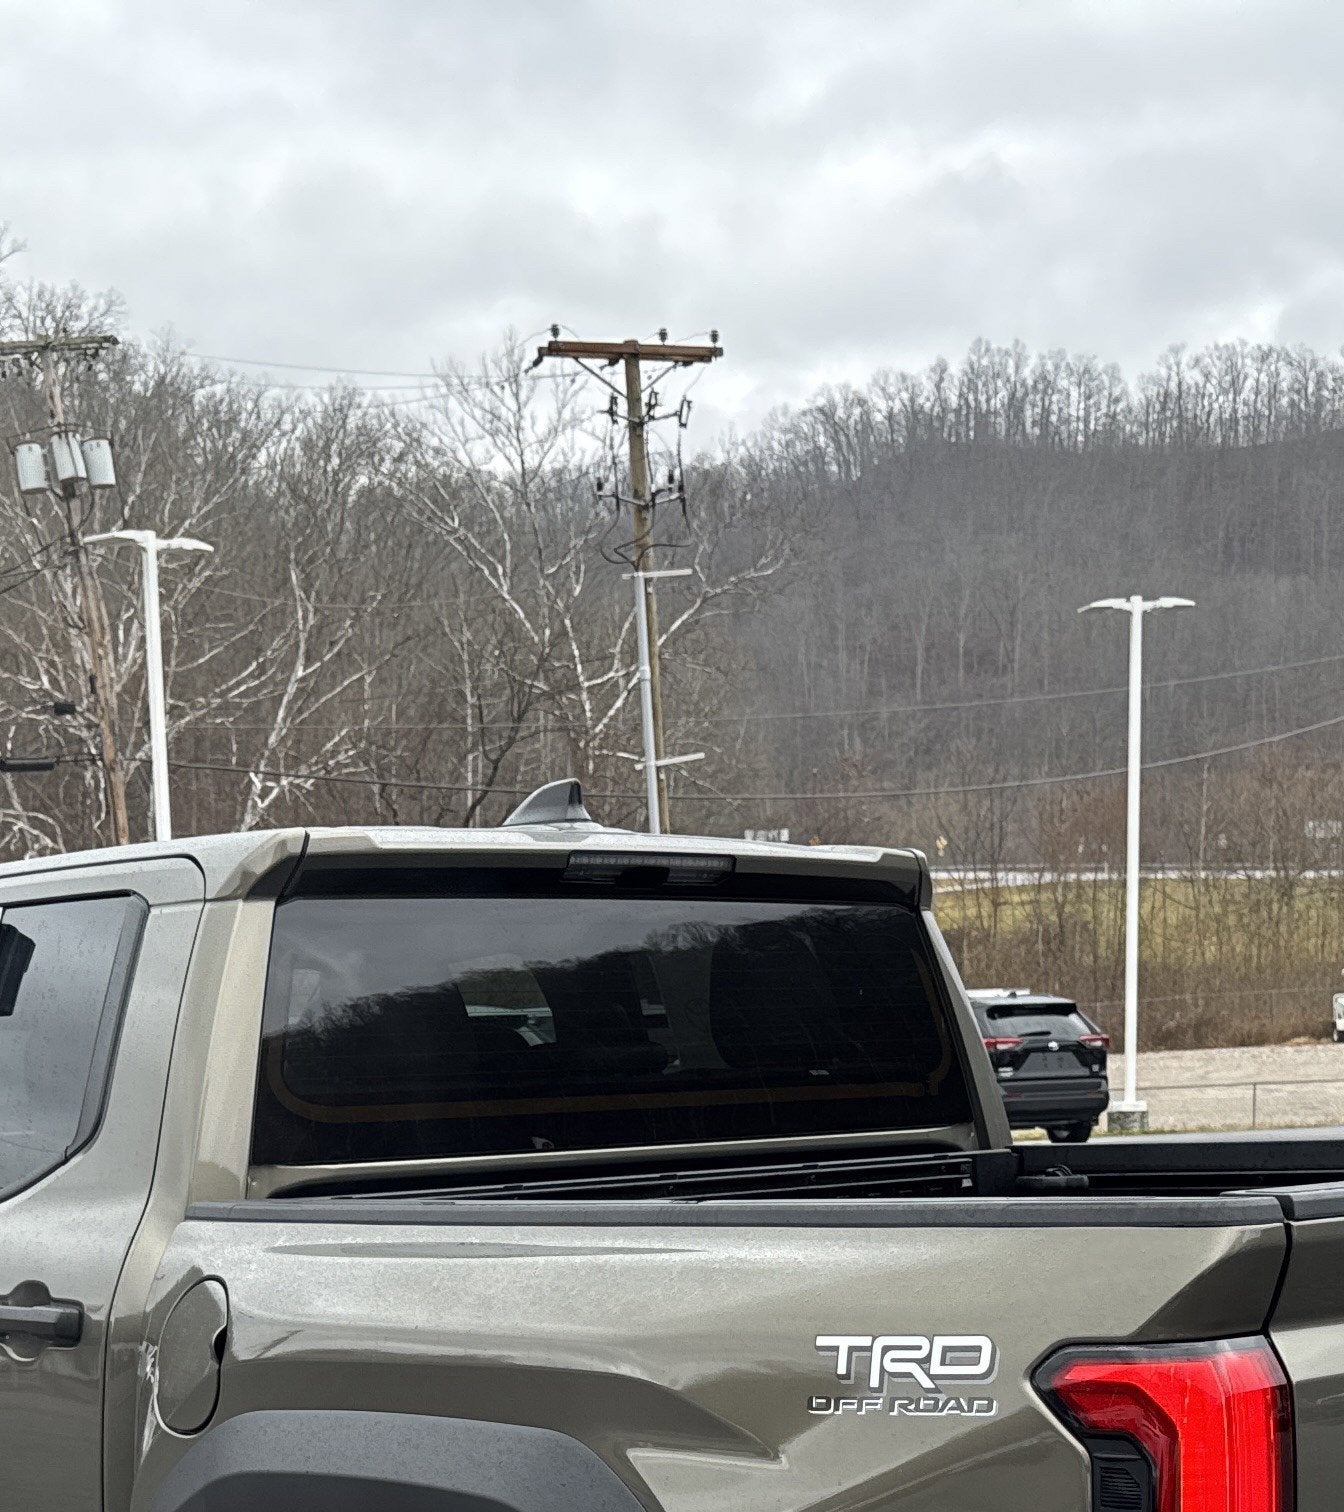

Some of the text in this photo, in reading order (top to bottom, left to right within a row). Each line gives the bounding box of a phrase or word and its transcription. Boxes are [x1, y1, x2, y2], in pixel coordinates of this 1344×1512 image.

[815, 1335, 999, 1397] TRD
[807, 1395, 998, 1416] OFF ROAD
